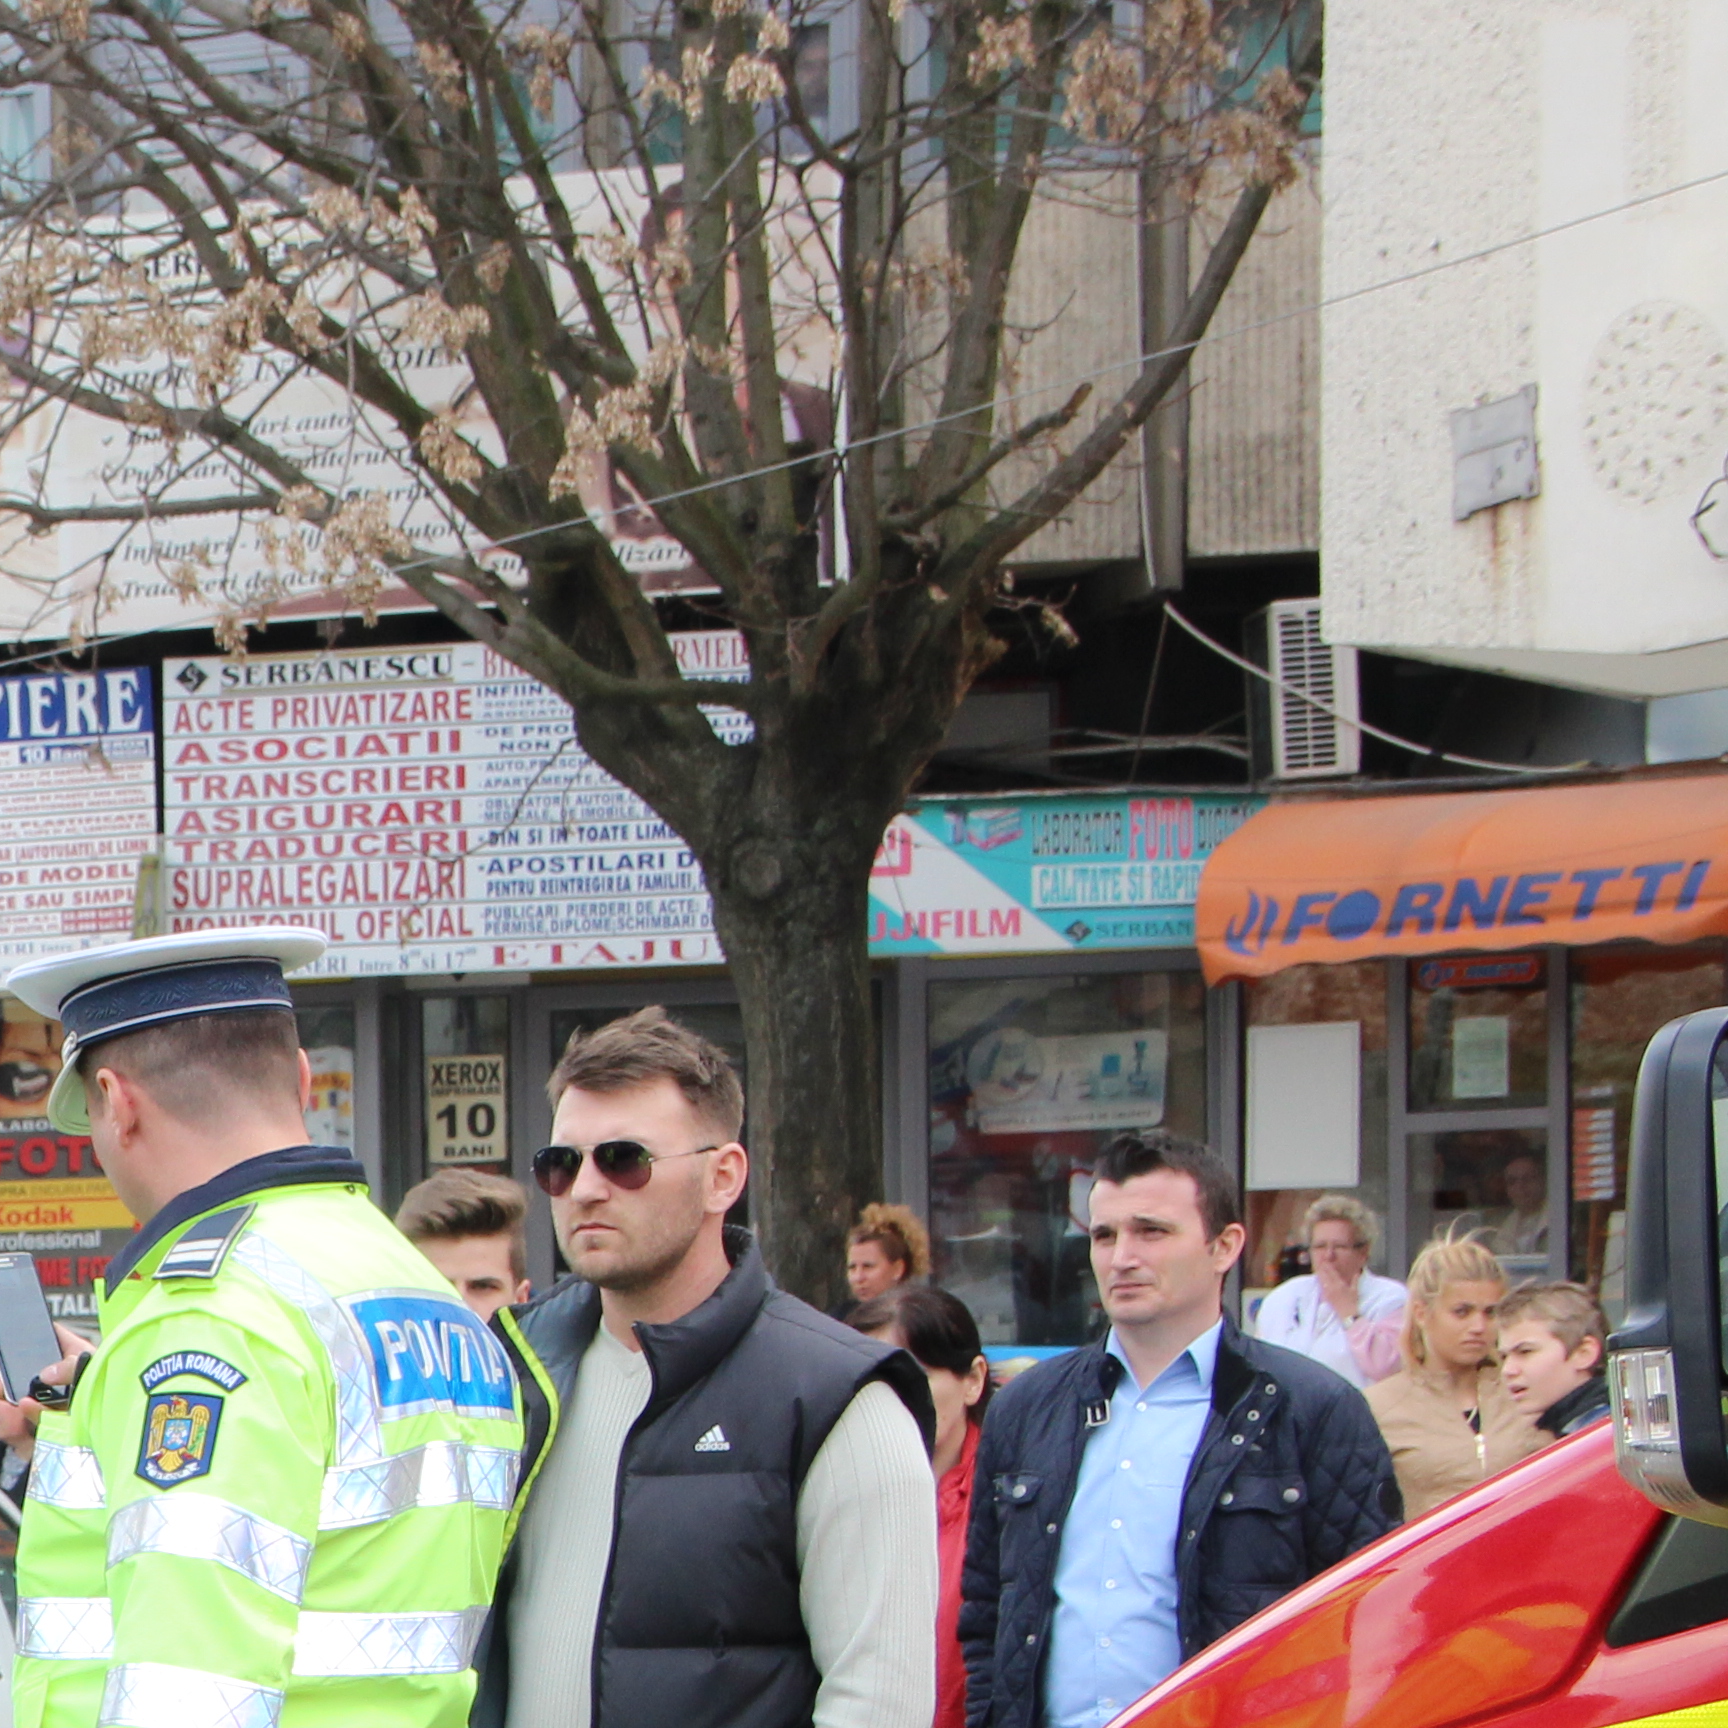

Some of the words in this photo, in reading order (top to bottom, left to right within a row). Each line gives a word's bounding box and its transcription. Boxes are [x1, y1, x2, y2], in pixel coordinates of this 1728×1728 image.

[221, 655, 453, 688] SERBANESCU
[173, 700, 254, 733] ACTE
[272, 688, 473, 730] PRIVATIZARE
[21, 746, 45, 764] 10
[175, 730, 461, 765] ASOCIATII
[173, 765, 466, 801] TRANSCRIERI
[174, 799, 462, 834] ASIGURARI
[1128, 797, 1194, 861] FOTO
[173, 830, 467, 862] TRADUCERI
[577, 823, 629, 842] TOATE
[40, 863, 135, 884] MODEL
[487, 852, 666, 876] APOSTILARI
[24, 891, 65, 908] SAU
[72, 888, 136, 906] SIMPL
[172, 857, 466, 911] SUPRALEGALIZARI
[486, 877, 535, 898] PENTRU
[540, 873, 632, 896] REINTREGIREA
[1039, 866, 1122, 903] CALITATE
[484, 902, 559, 920] PUBLICARI
[566, 901, 632, 918] PIERDERI
[636, 900, 653, 916] DE
[1282, 860, 1712, 946] FORNETTI
[356, 907, 474, 941] OFICIAL
[1096, 920, 1194, 938] SERBAN
[492, 938, 709, 968] ETAJU
[432, 1061, 502, 1088] XEROX
[436, 1102, 495, 1140] 10
[443, 1144, 494, 1159] BANI
[694, 1441, 731, 1452] adidas
